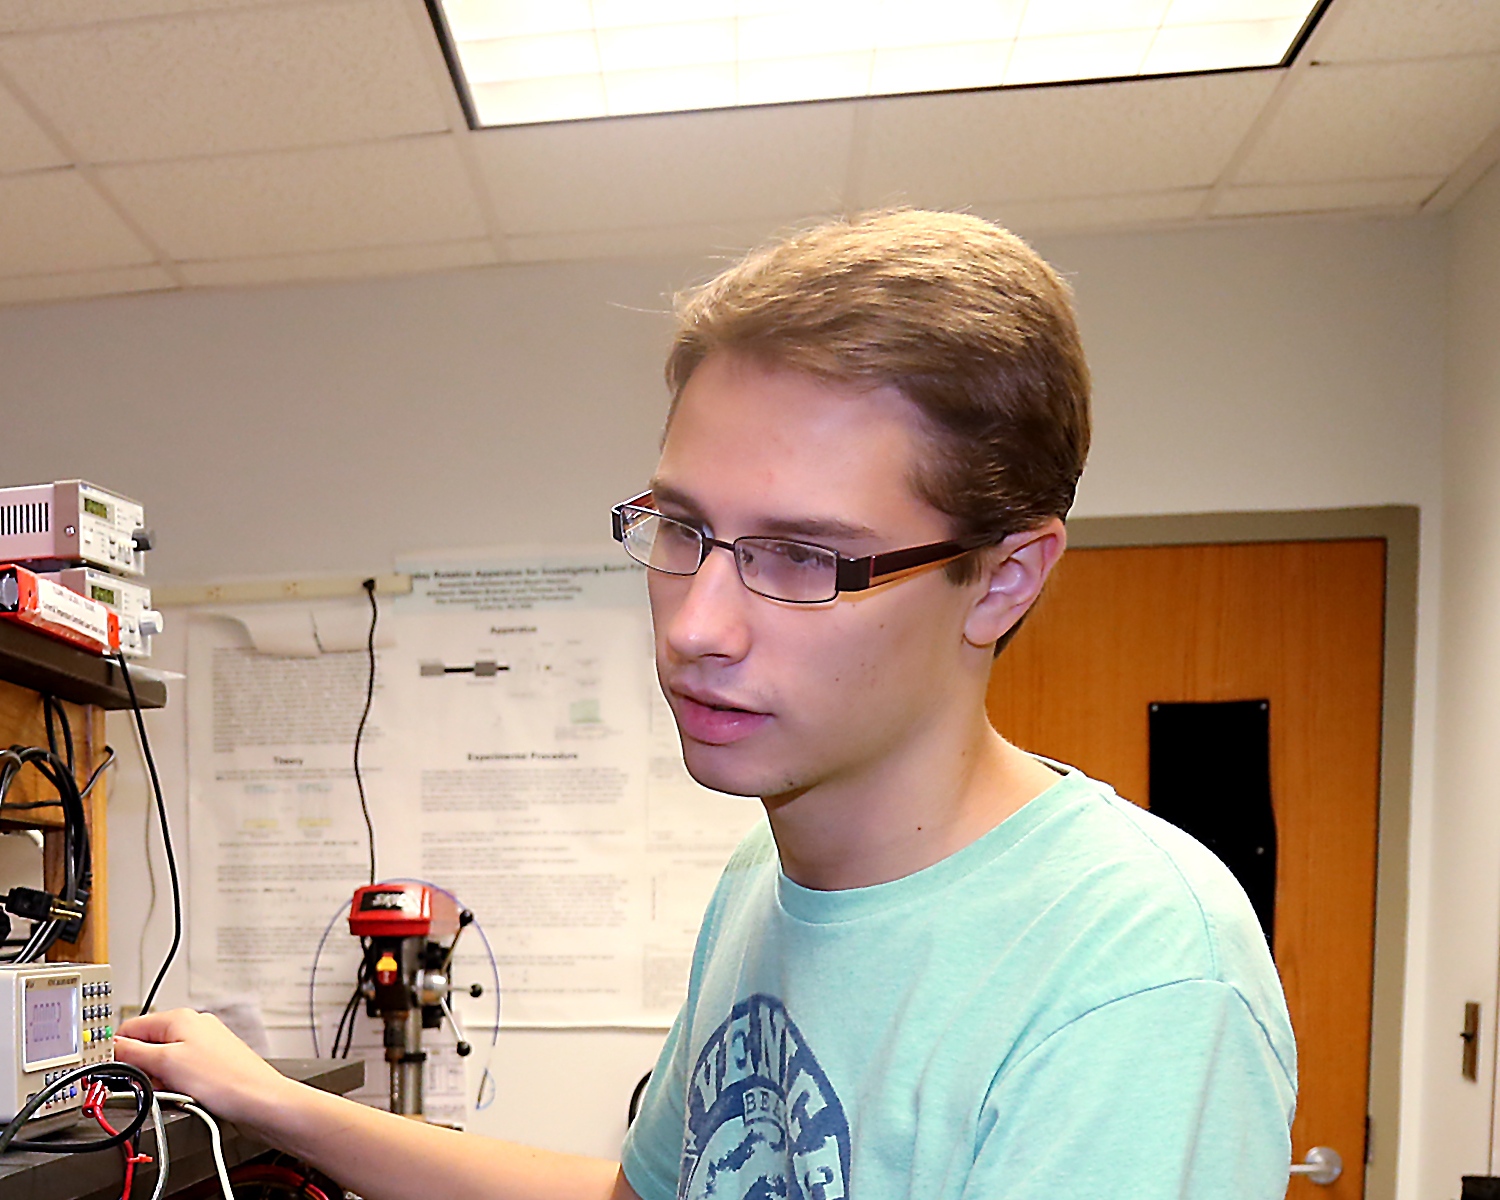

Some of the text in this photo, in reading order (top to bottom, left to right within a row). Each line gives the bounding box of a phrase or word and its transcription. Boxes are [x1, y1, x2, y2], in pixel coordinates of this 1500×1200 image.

[490, 625, 538, 635] Apparatus
[272, 755, 304, 766] Theory
[467, 751, 578, 762] Experimental Procedure
[743, 1089, 787, 1121] BEA
